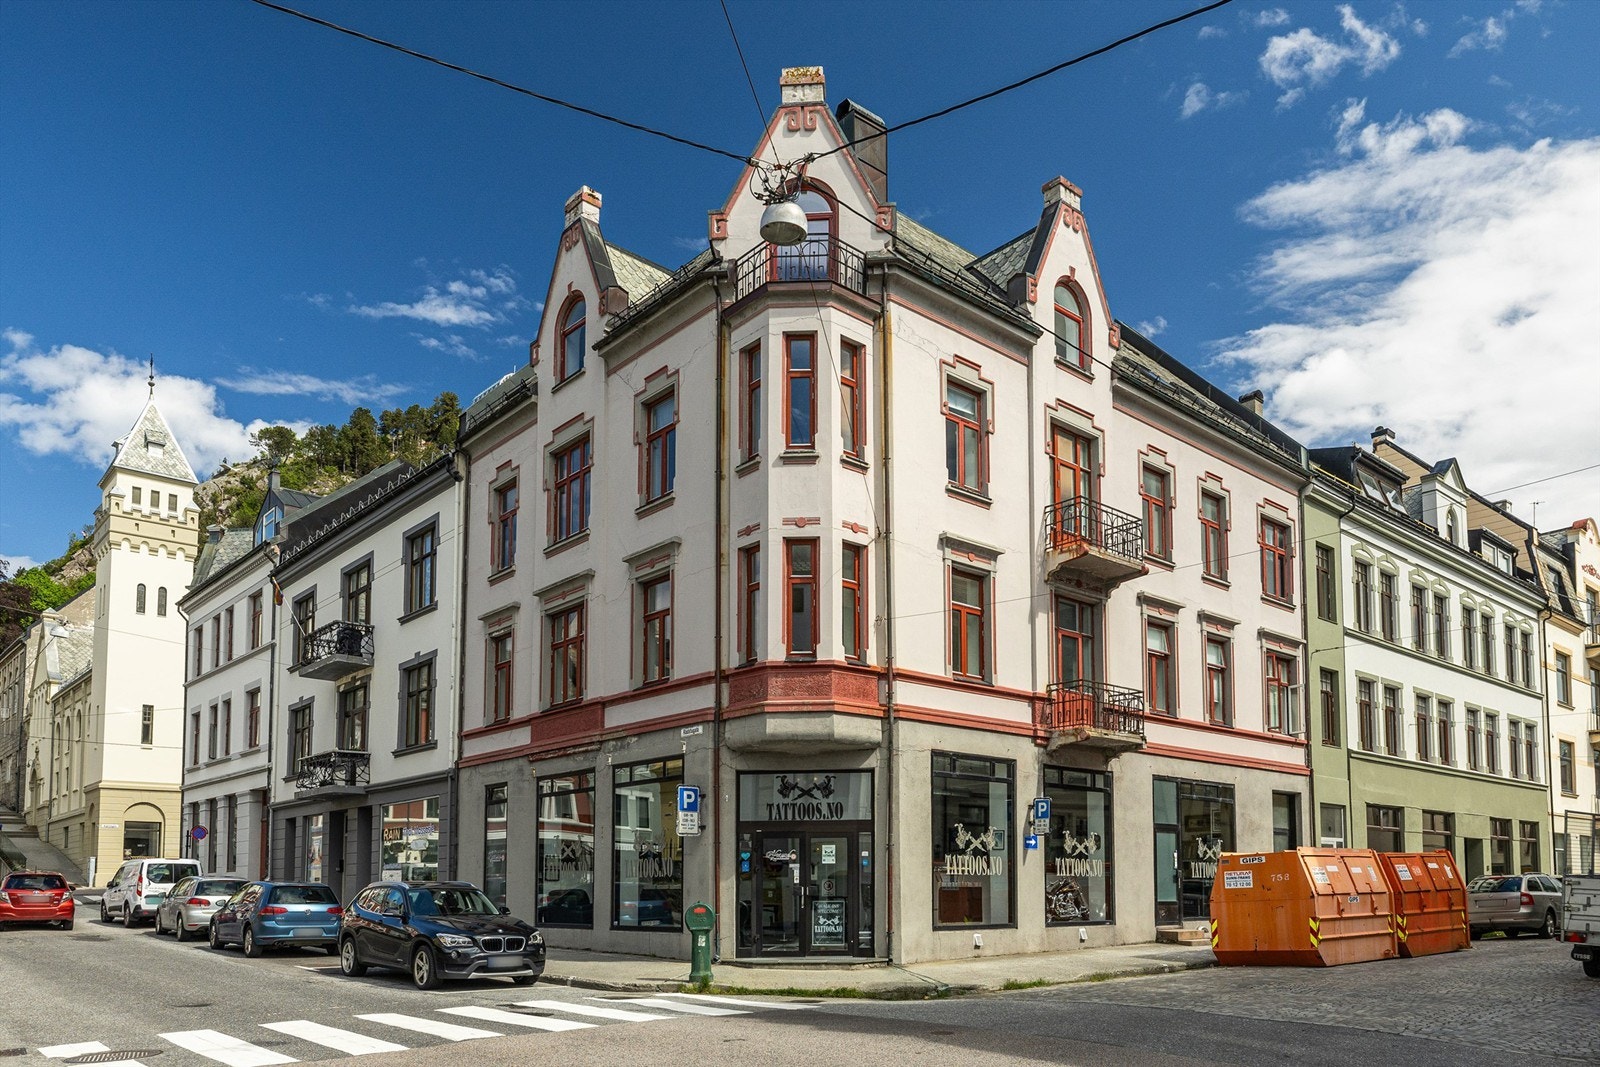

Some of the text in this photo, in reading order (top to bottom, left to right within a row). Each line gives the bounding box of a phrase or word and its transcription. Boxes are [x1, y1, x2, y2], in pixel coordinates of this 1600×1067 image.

[683, 790, 695, 809] P
[1038, 802, 1047, 817] P
[766, 801, 844, 821] TATTOOS.NO
[624, 857, 674, 878] TATTOOS.NO
[944, 853, 1003, 876] TATTOOS.NO
[1055, 857, 1103, 878] TATTOOS.NO
[814, 925, 843, 933] TATTOOS.NO
